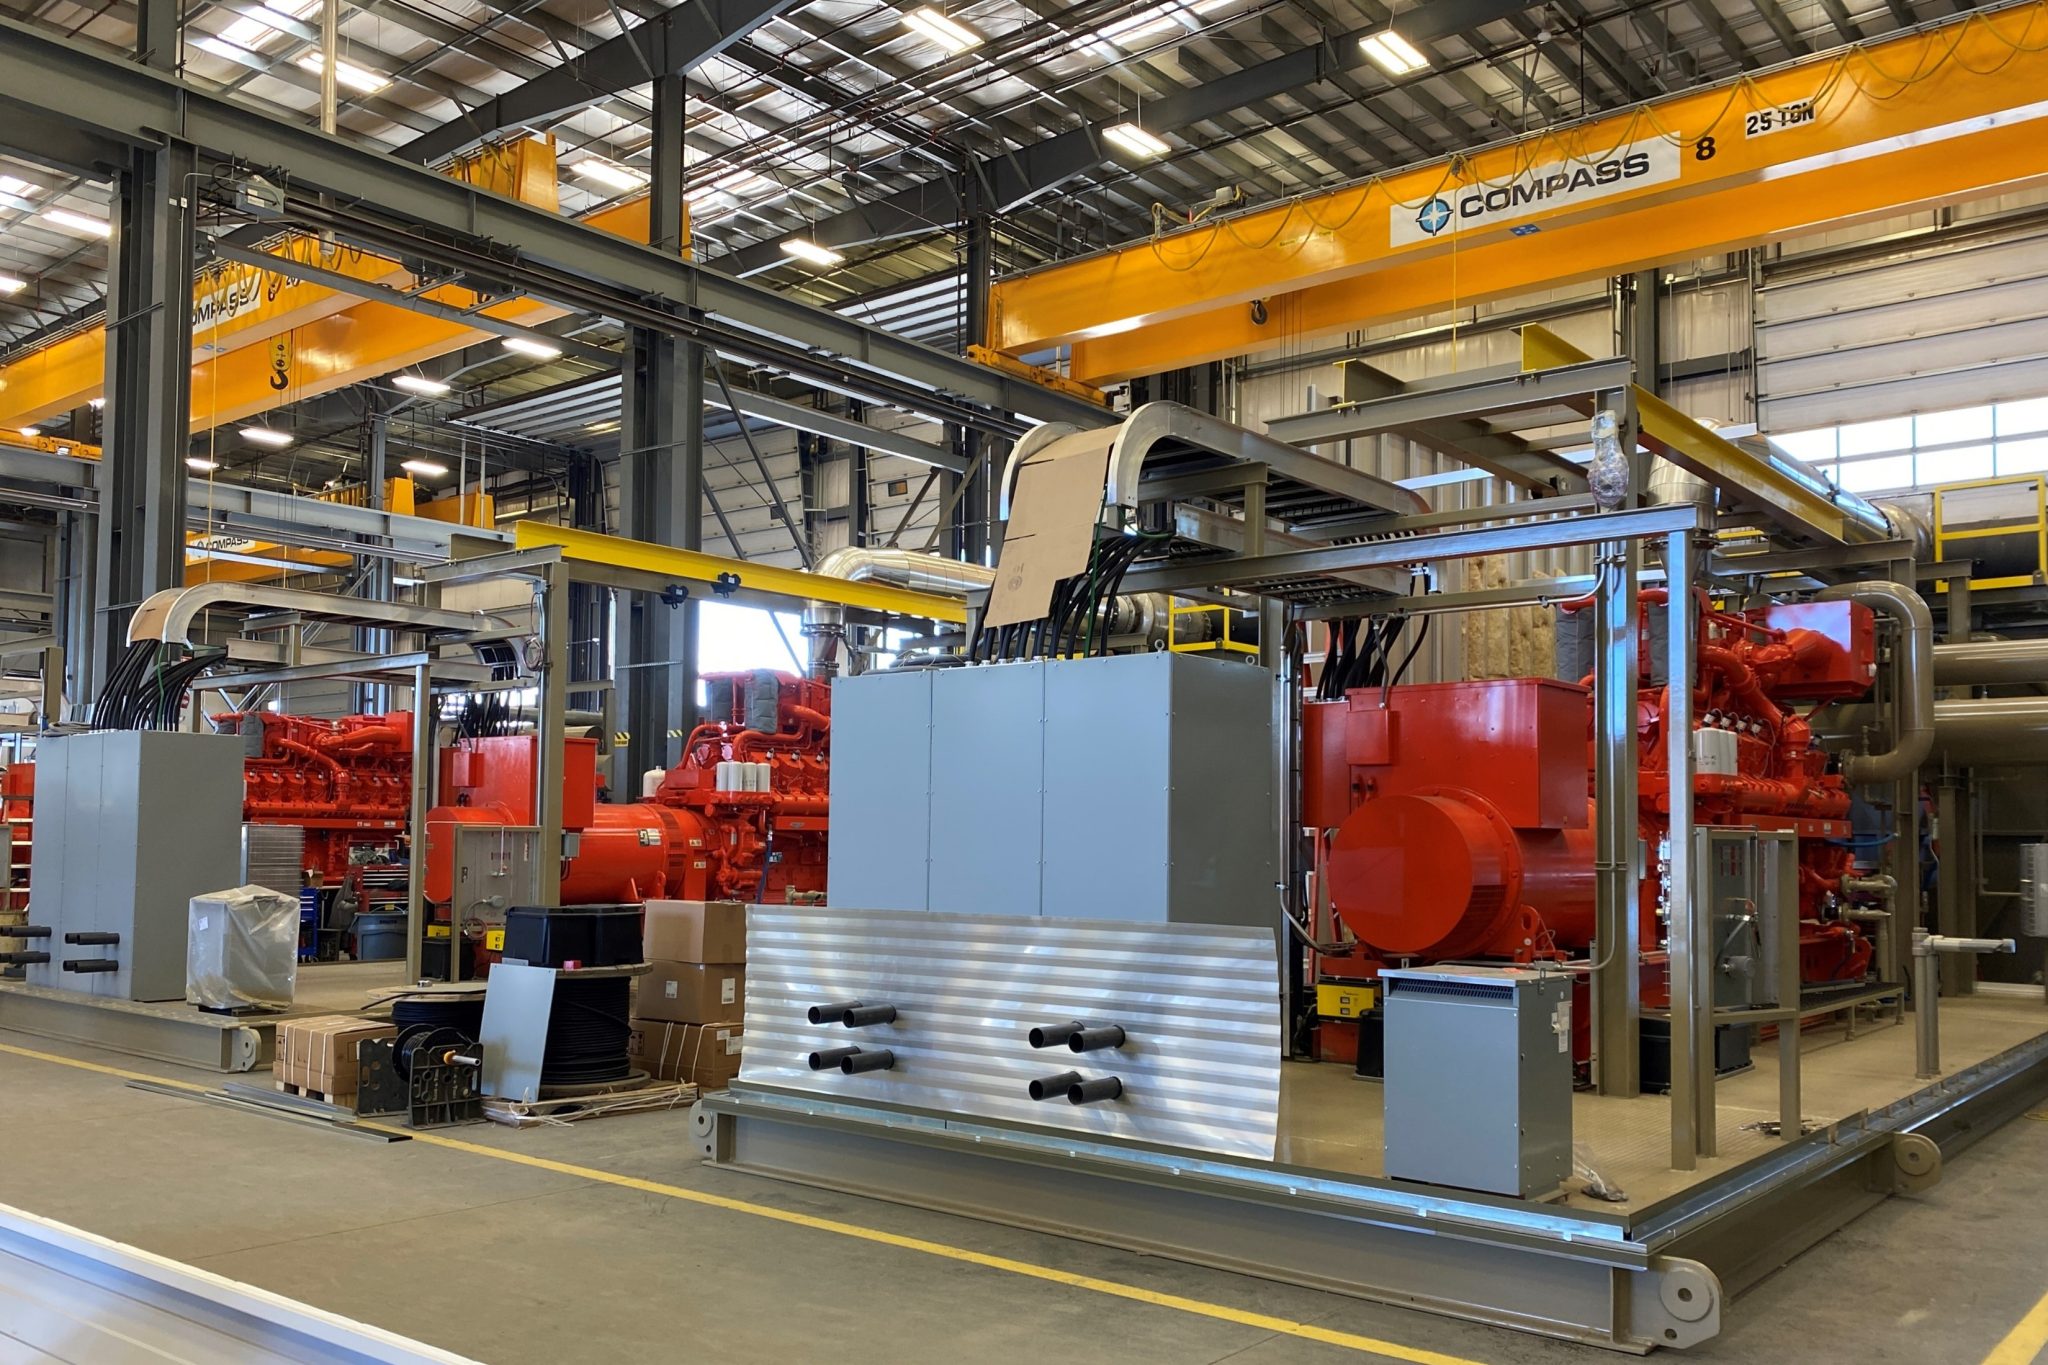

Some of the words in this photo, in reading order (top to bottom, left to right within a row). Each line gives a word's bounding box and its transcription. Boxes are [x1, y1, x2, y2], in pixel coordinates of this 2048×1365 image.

[1746, 111, 1772, 136] 25
[1777, 102, 1815, 127] TON
[1695, 136, 1716, 161] 8
[1460, 152, 1650, 218] COMPASS
